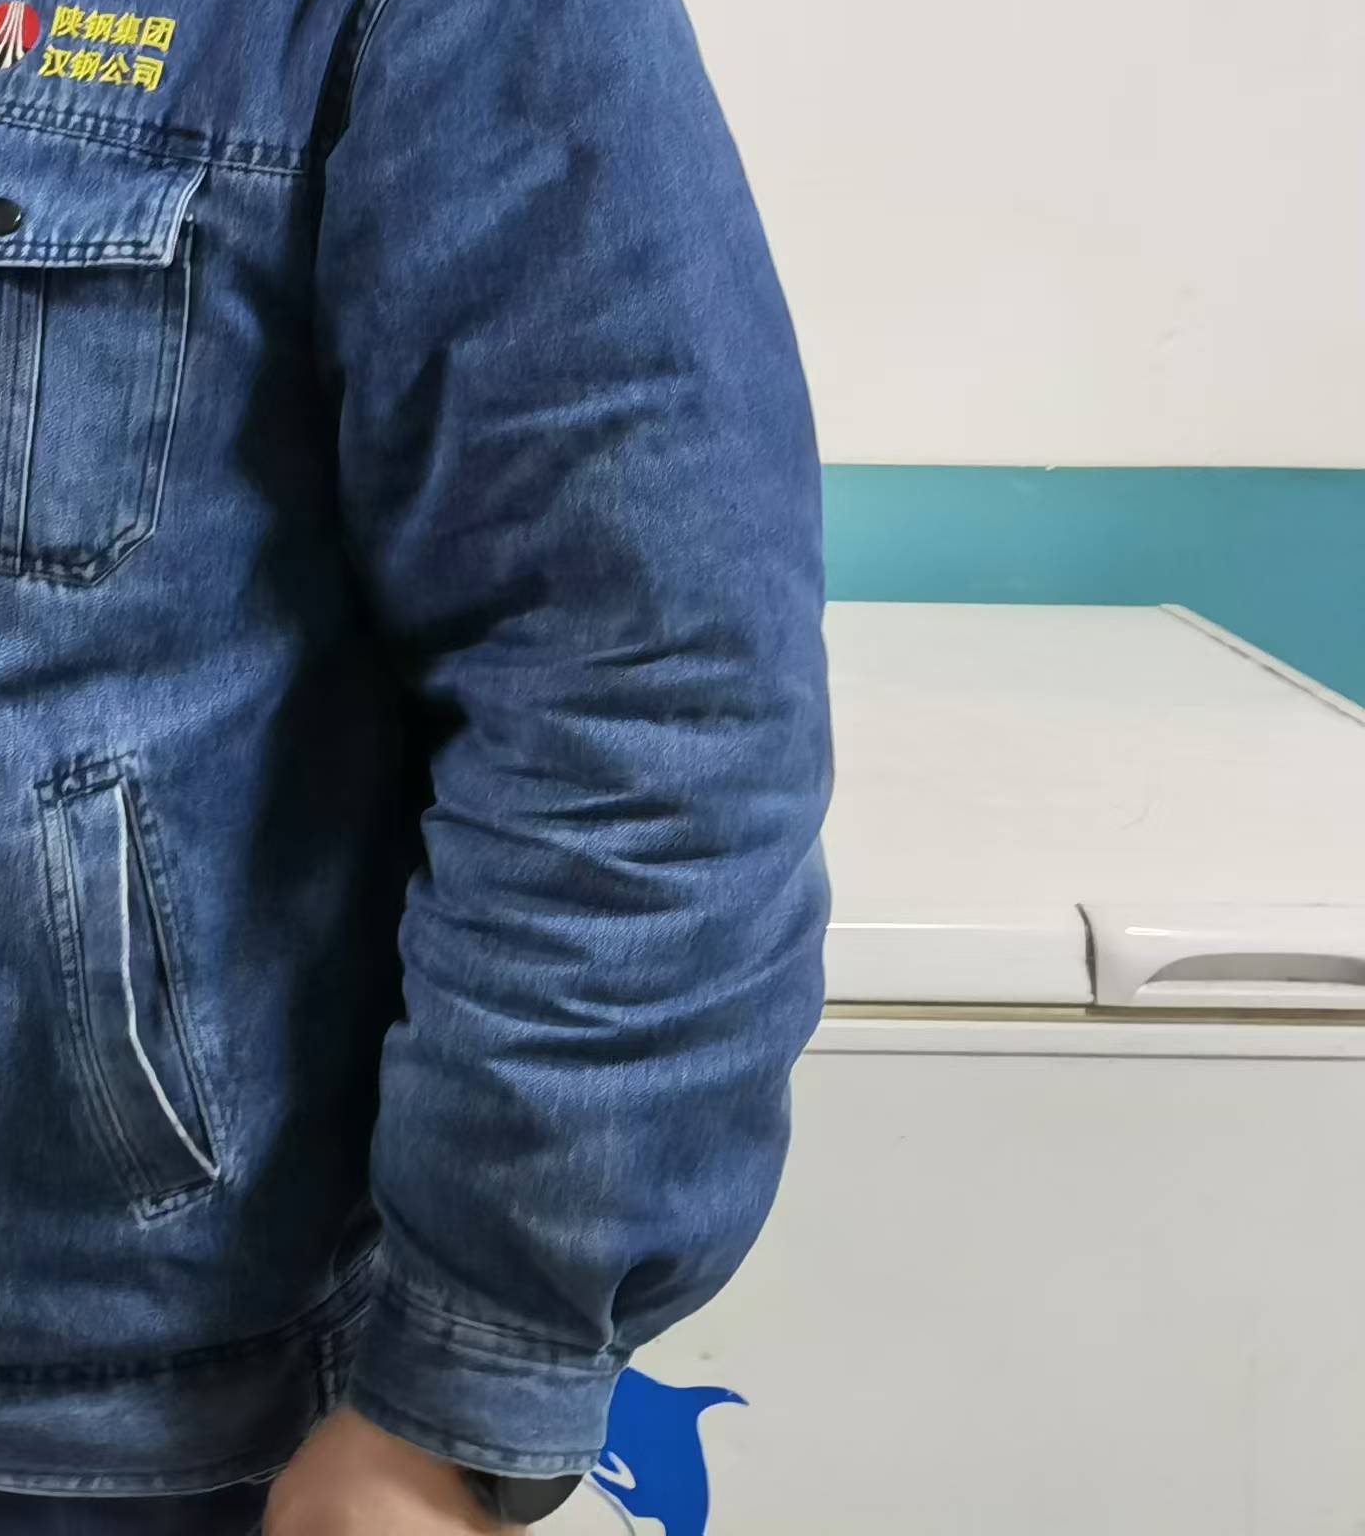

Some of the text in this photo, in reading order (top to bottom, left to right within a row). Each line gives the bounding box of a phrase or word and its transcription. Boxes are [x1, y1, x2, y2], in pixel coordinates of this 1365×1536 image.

[50, 5, 176, 53] 陕钢集团
[38, 44, 165, 93] 汉钢公司
